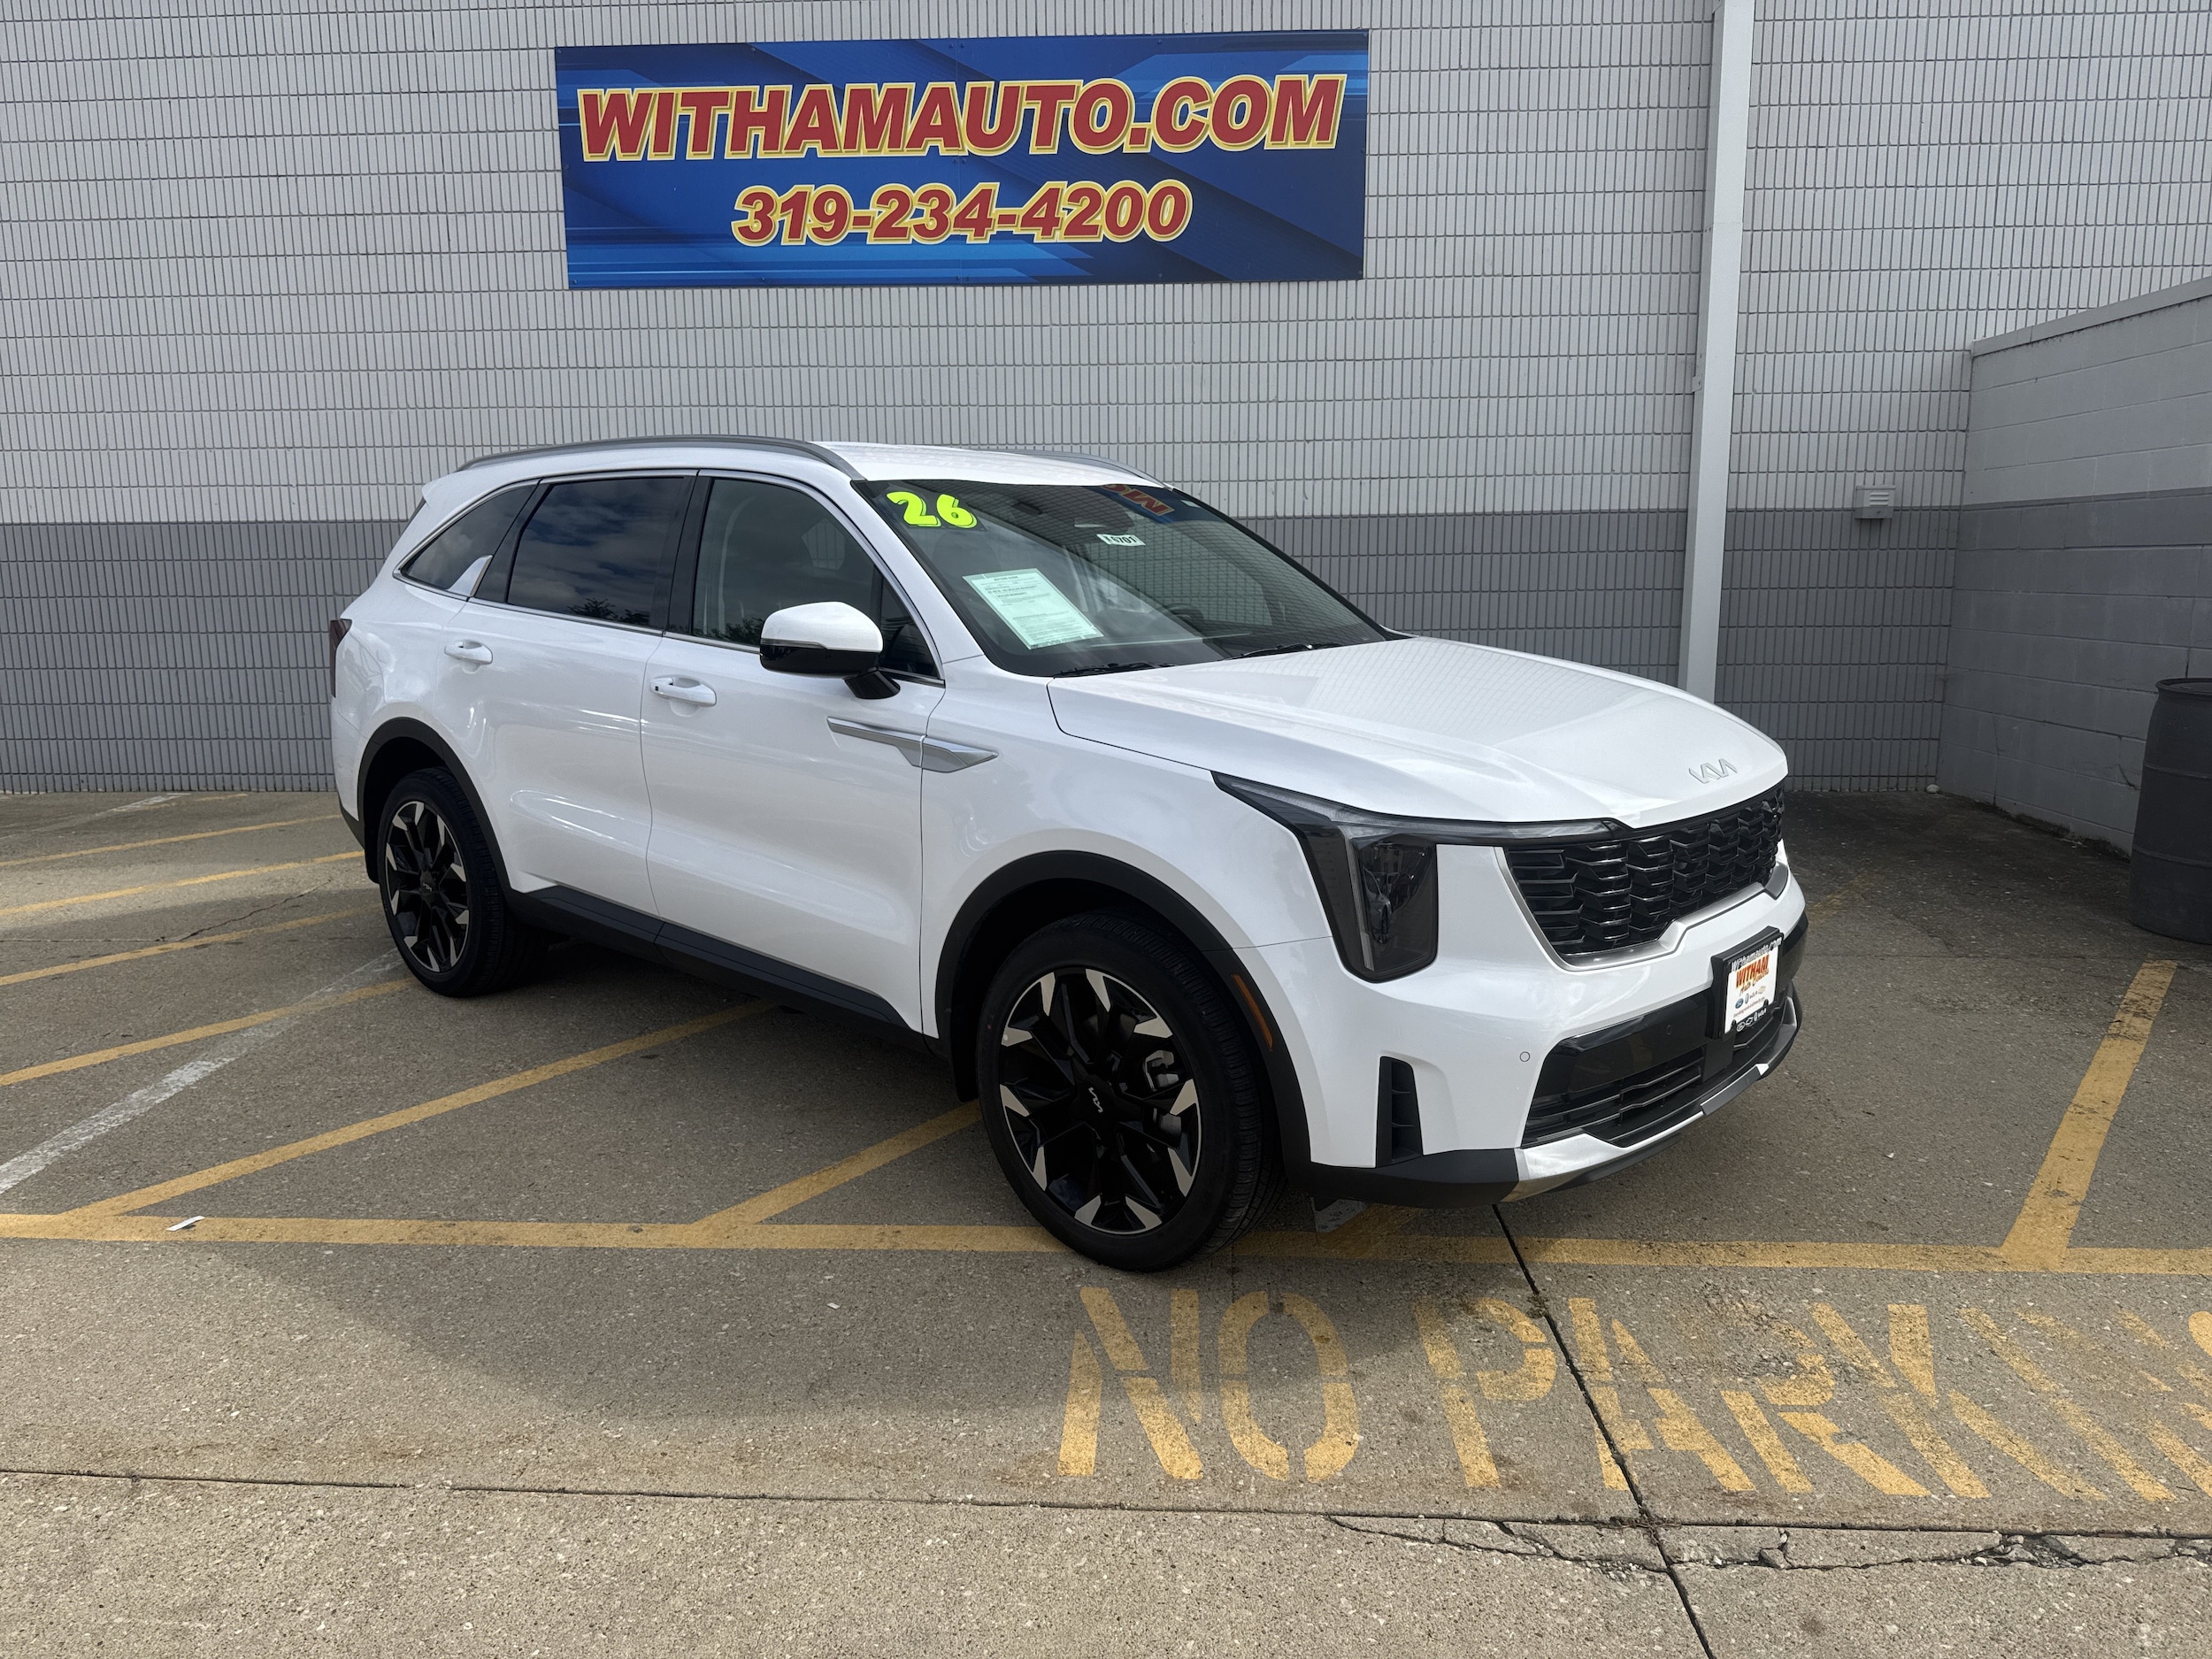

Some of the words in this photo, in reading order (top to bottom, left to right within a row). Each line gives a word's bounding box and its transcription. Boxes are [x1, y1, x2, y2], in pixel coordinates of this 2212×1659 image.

[576, 73, 1347, 163] WITHAMAUTO.COM
[731, 180, 1193, 247] 319-234-4200
[886, 490, 978, 529] 26
[1688, 758, 1738, 784] KIA
[1737, 954, 1770, 988] WITHAM
[1057, 1286, 1360, 1483] NO
